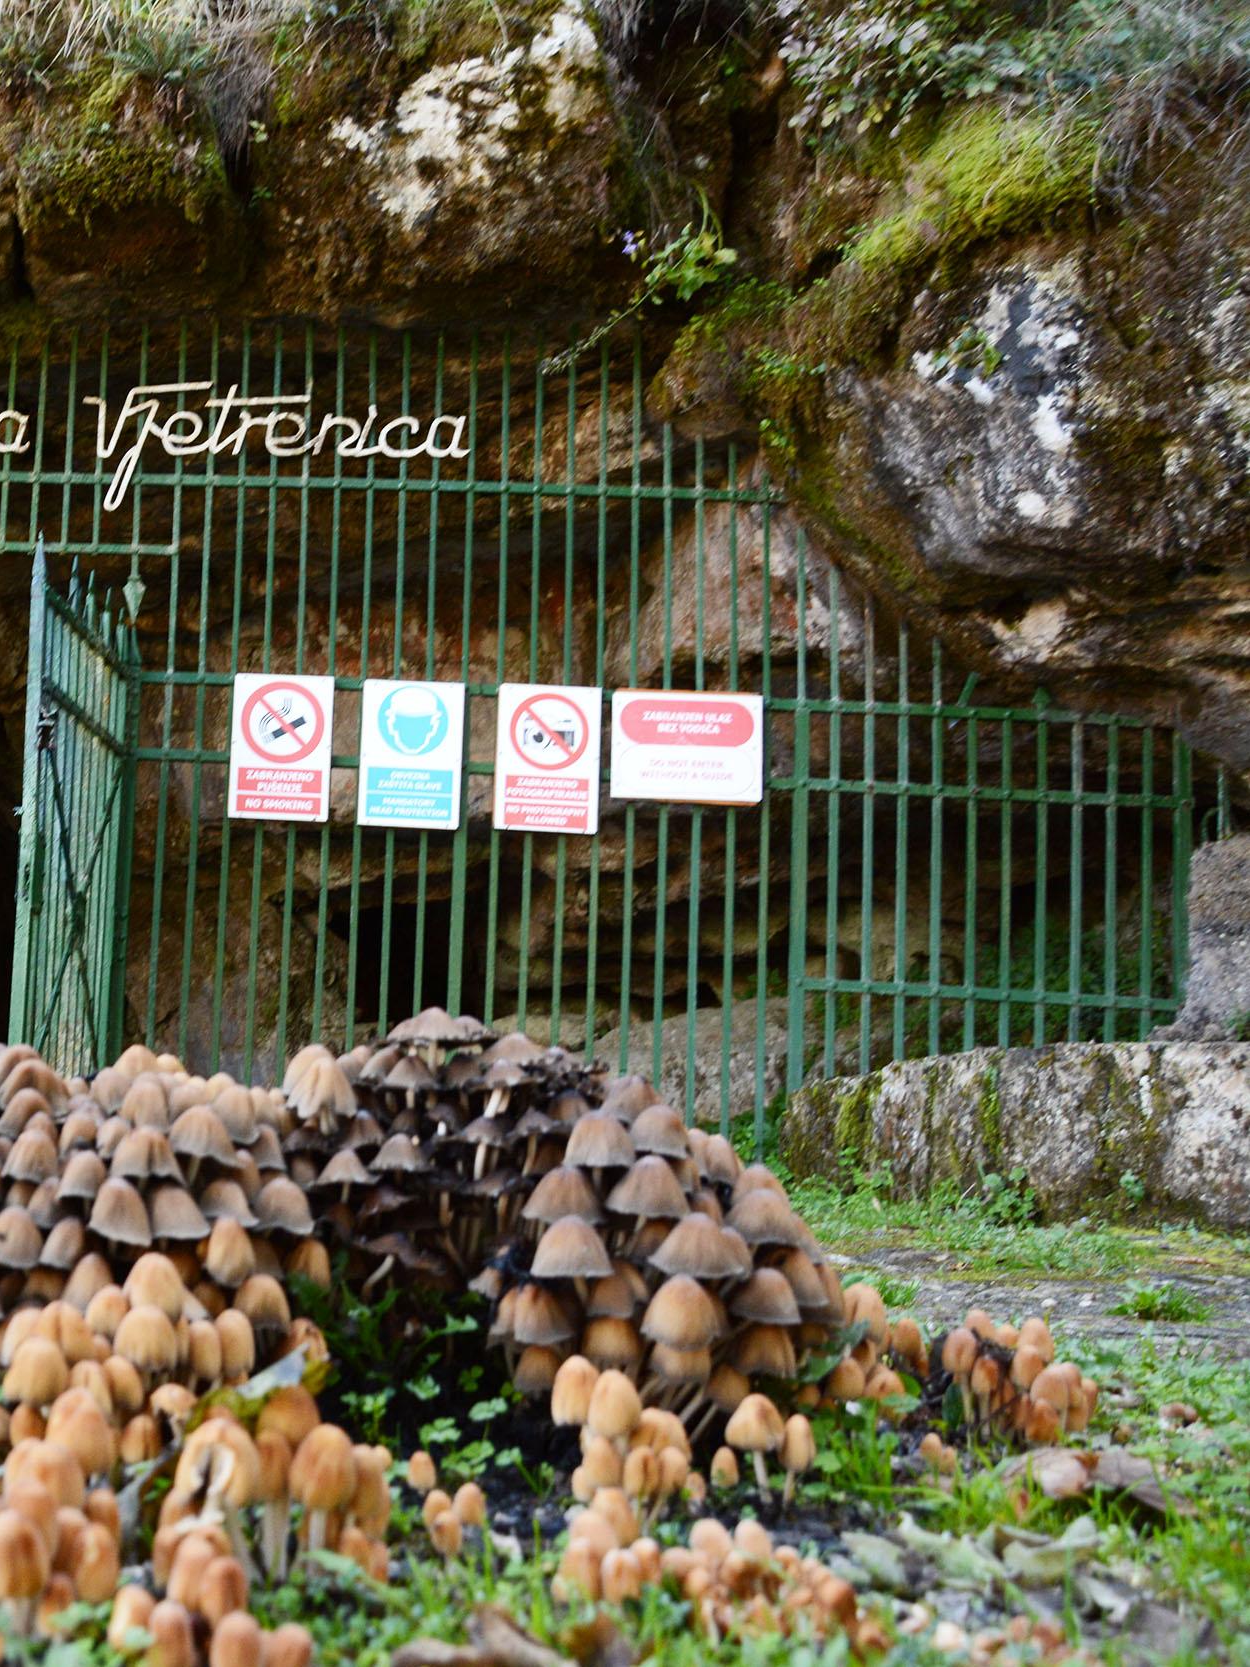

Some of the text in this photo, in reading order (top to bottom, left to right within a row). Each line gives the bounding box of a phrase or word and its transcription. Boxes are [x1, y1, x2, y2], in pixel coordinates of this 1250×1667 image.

[83, 381, 471, 512] Vjetrenica
[642, 711, 733, 723] ZABRANJEN ULAZ
[657, 722, 678, 733] BEZ
[667, 759, 688, 768] NOT
[691, 759, 724, 769] ENTER
[246, 769, 314, 782] ZABRANJENO
[640, 770, 688, 780] WITHOUT
[701, 771, 734, 781] GUIDE
[516, 777, 579, 789] ZABRANJENO
[245, 797, 314, 811] NO SMOKING
[394, 807, 448, 818] PROTECTION
[506, 804, 586, 817] NO PHOTOGRAPHY
[524, 814, 568, 826] ALLOWED
